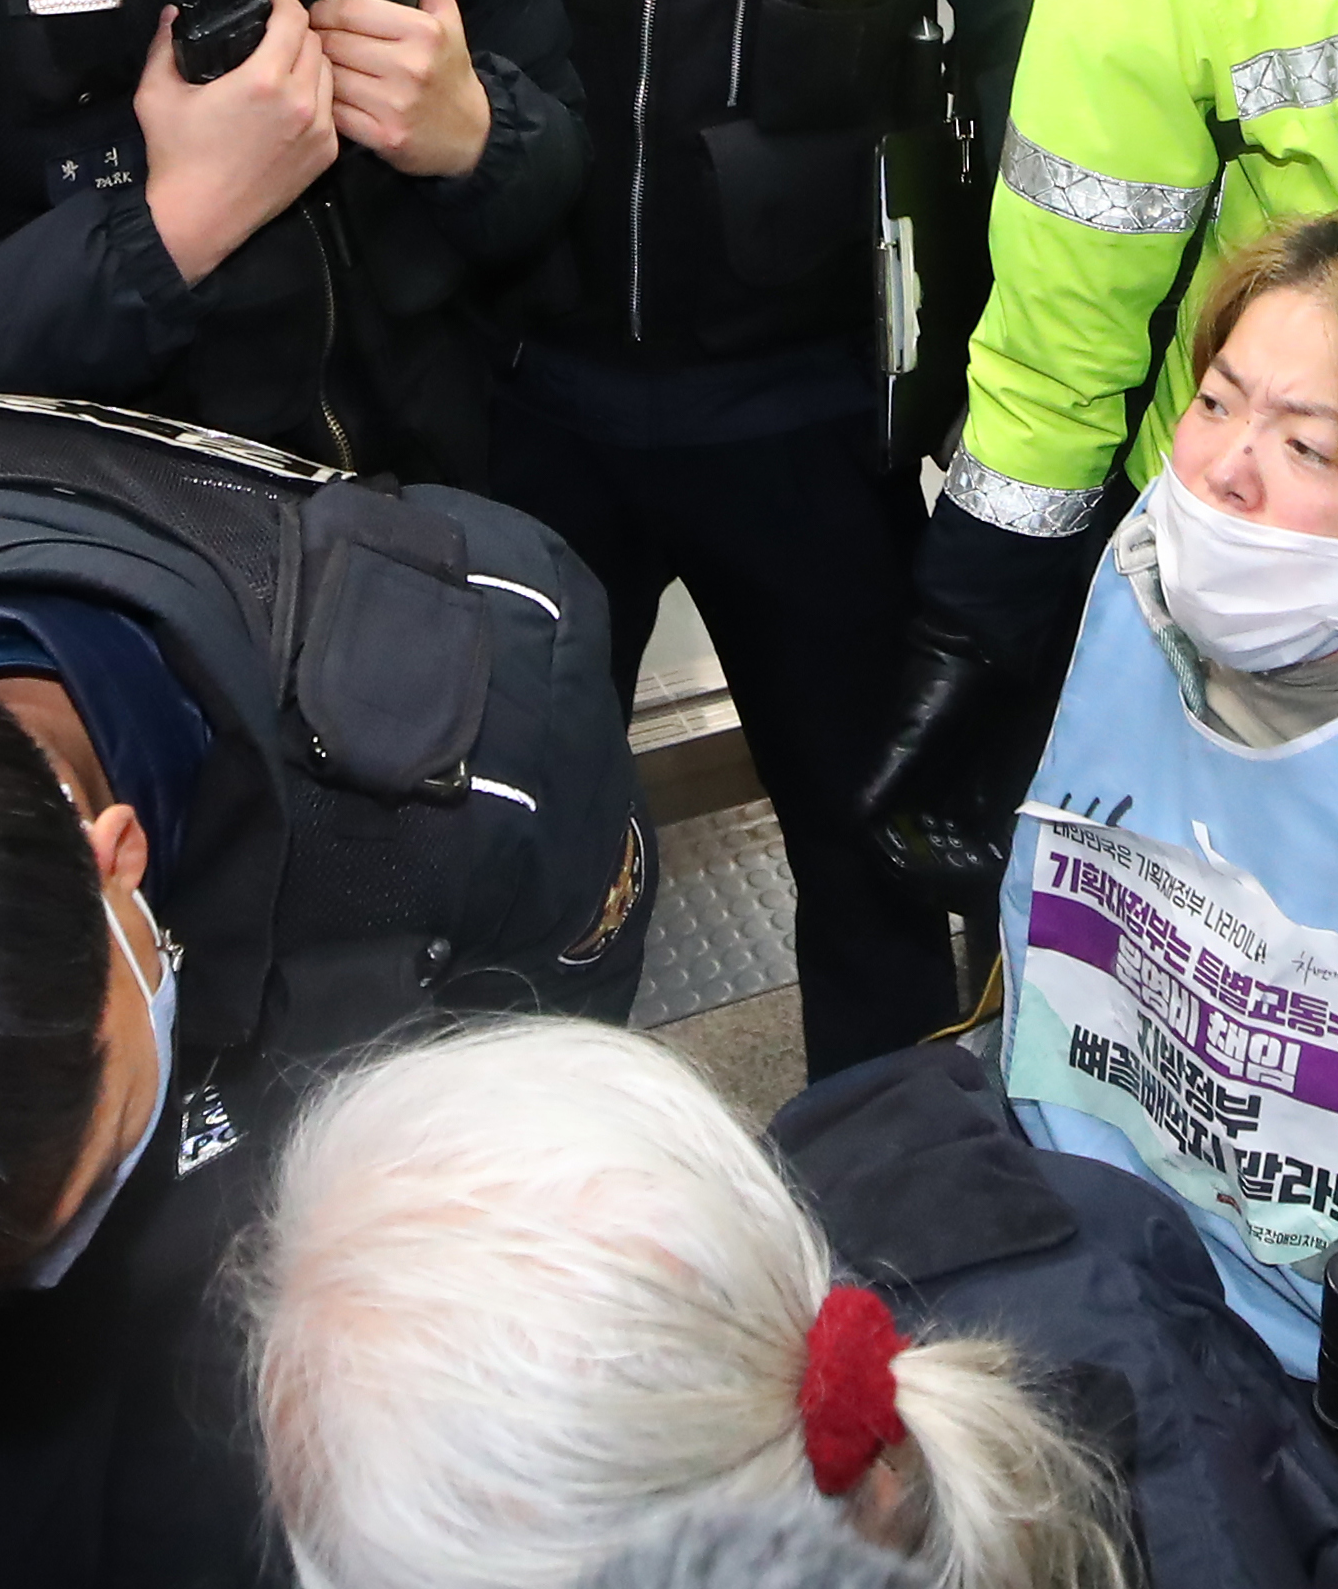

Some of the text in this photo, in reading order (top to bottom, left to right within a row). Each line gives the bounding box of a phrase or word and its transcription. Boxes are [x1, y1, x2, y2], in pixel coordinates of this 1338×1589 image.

[95, 171, 133, 188] PARK
[1050, 851, 1192, 974] 기획재정부는
[1205, 1011, 1301, 1094] 책임
